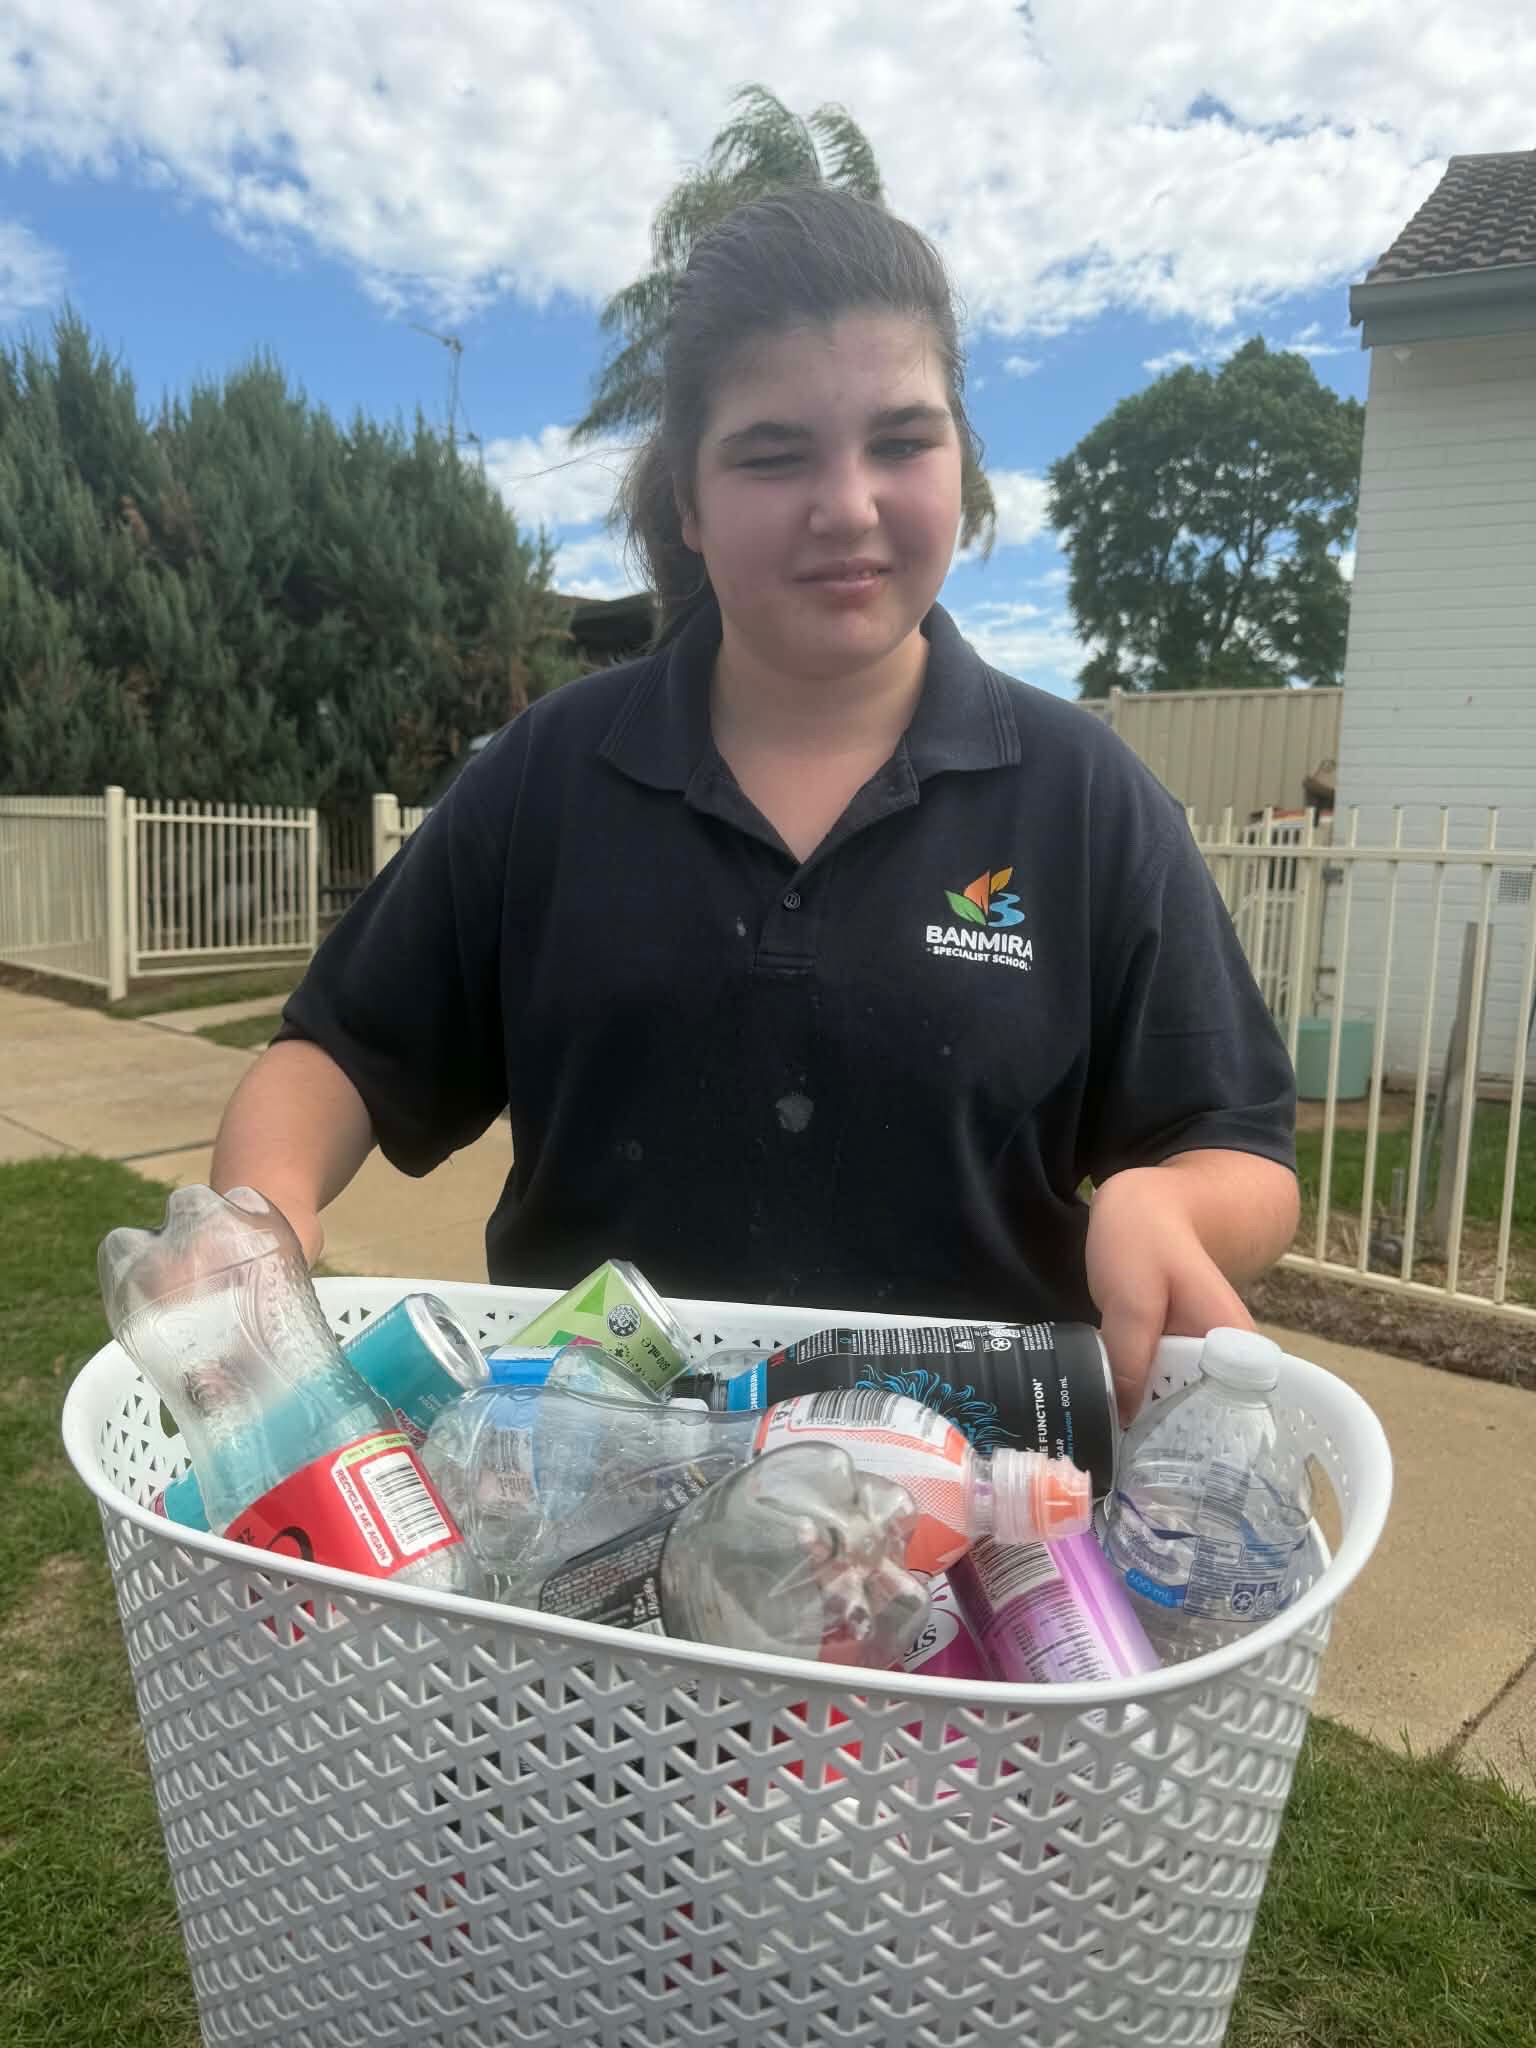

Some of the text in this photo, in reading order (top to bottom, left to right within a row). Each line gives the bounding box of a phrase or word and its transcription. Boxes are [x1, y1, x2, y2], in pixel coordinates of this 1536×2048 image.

[926, 925, 1033, 962] BANMIRA
[933, 945, 1029, 972] SPECIALIST SCHOOL
[335, 1468, 363, 1513] RECYCLE
[359, 1511, 372, 1529] ME
[367, 1527, 388, 1561] AGAIN
